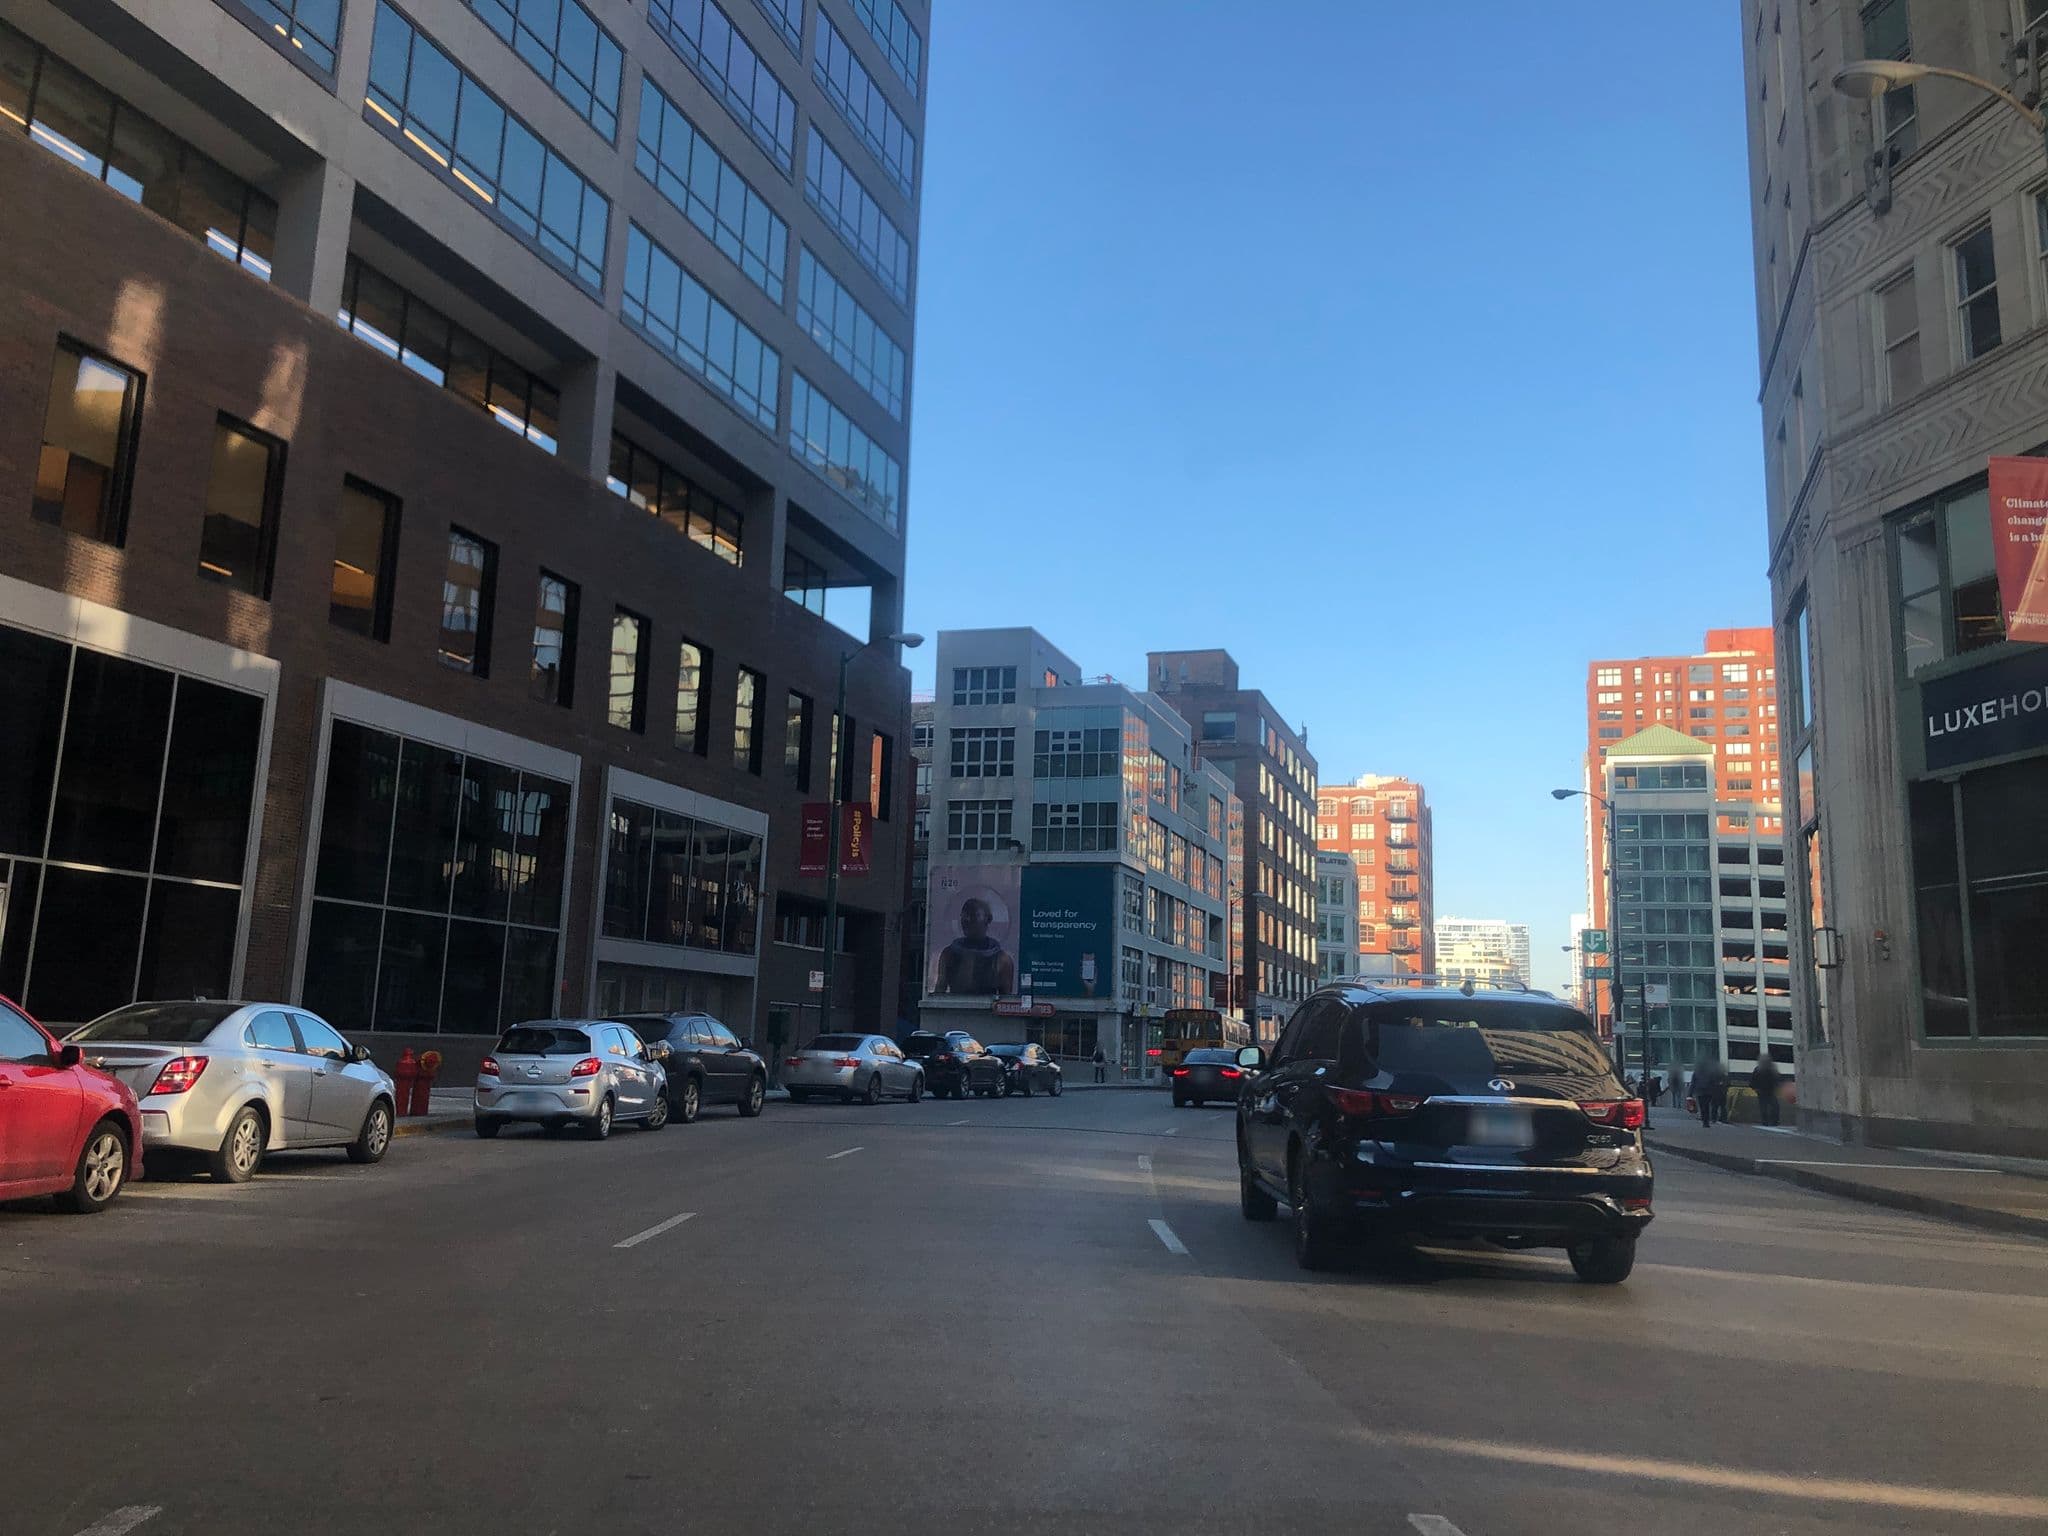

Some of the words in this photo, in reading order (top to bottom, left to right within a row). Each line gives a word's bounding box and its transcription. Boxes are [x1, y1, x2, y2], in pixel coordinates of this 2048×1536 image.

[1032, 909, 1061, 918] Loved
[1064, 909, 1079, 918] for
[1032, 921, 1097, 931] transparency
